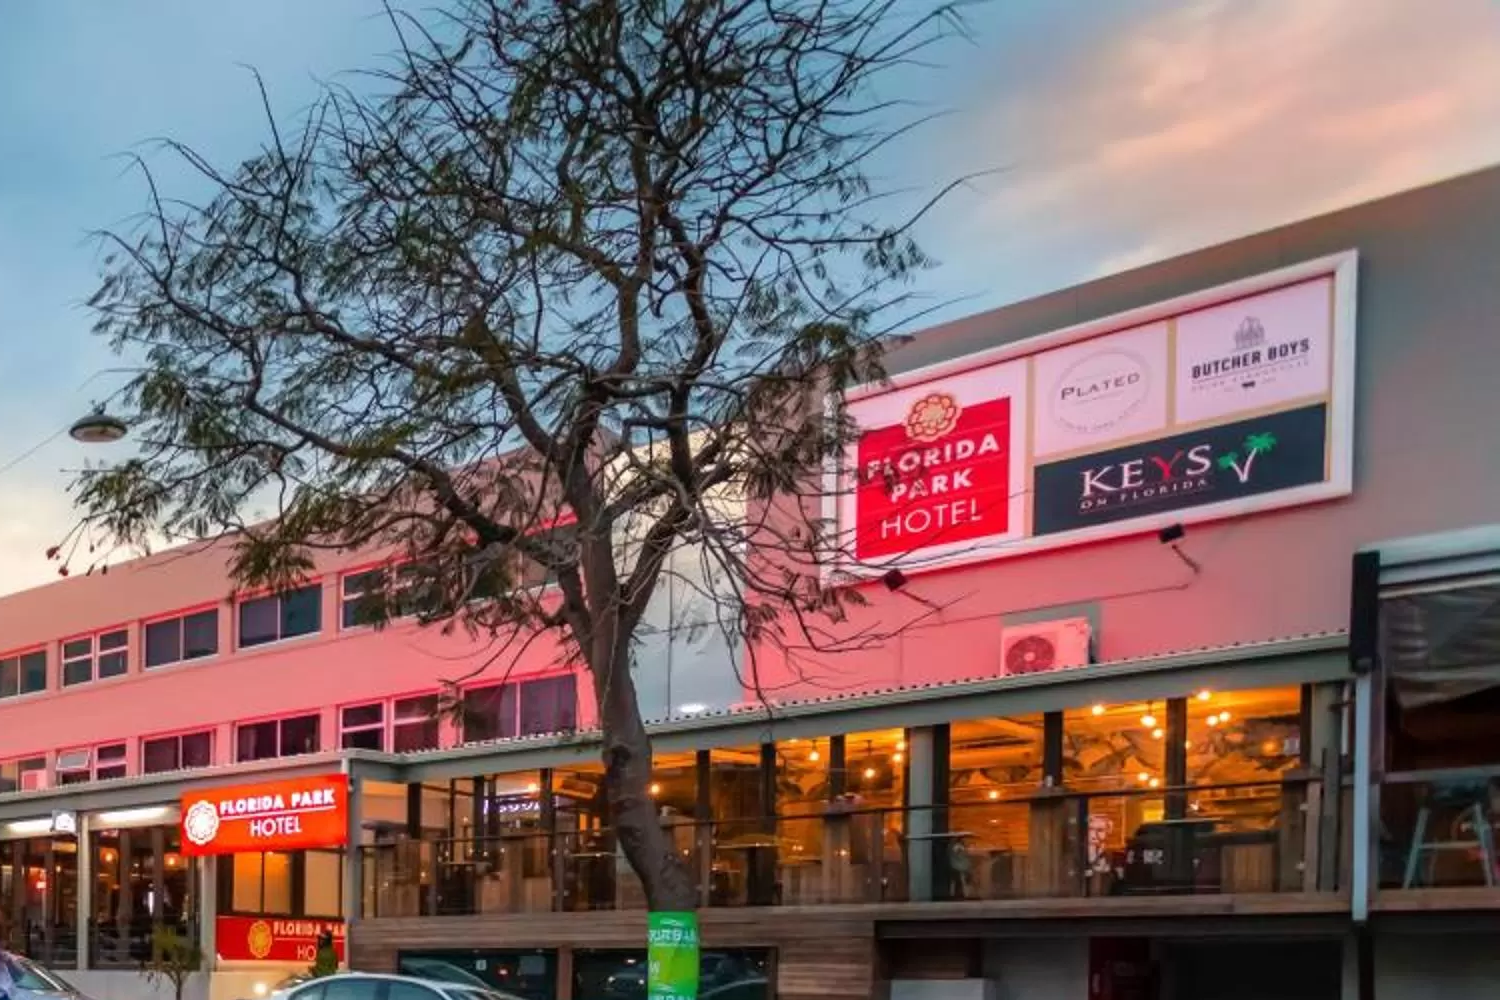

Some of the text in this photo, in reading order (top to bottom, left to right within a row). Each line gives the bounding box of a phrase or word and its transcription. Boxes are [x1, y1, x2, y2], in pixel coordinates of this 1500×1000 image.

[1191, 350, 1261, 379] BUTCHER
[1267, 338, 1309, 361] BOYS
[1061, 371, 1140, 401] PLATED
[866, 433, 1000, 480] FLORIDA
[1080, 444, 1212, 497] KEYS
[891, 467, 973, 503] PARK
[1079, 479, 1208, 510] ON FLORIDA
[881, 497, 983, 540] HOTEL
[220, 788, 336, 815] FLORIDA PARK
[250, 816, 303, 837] HOTEL
